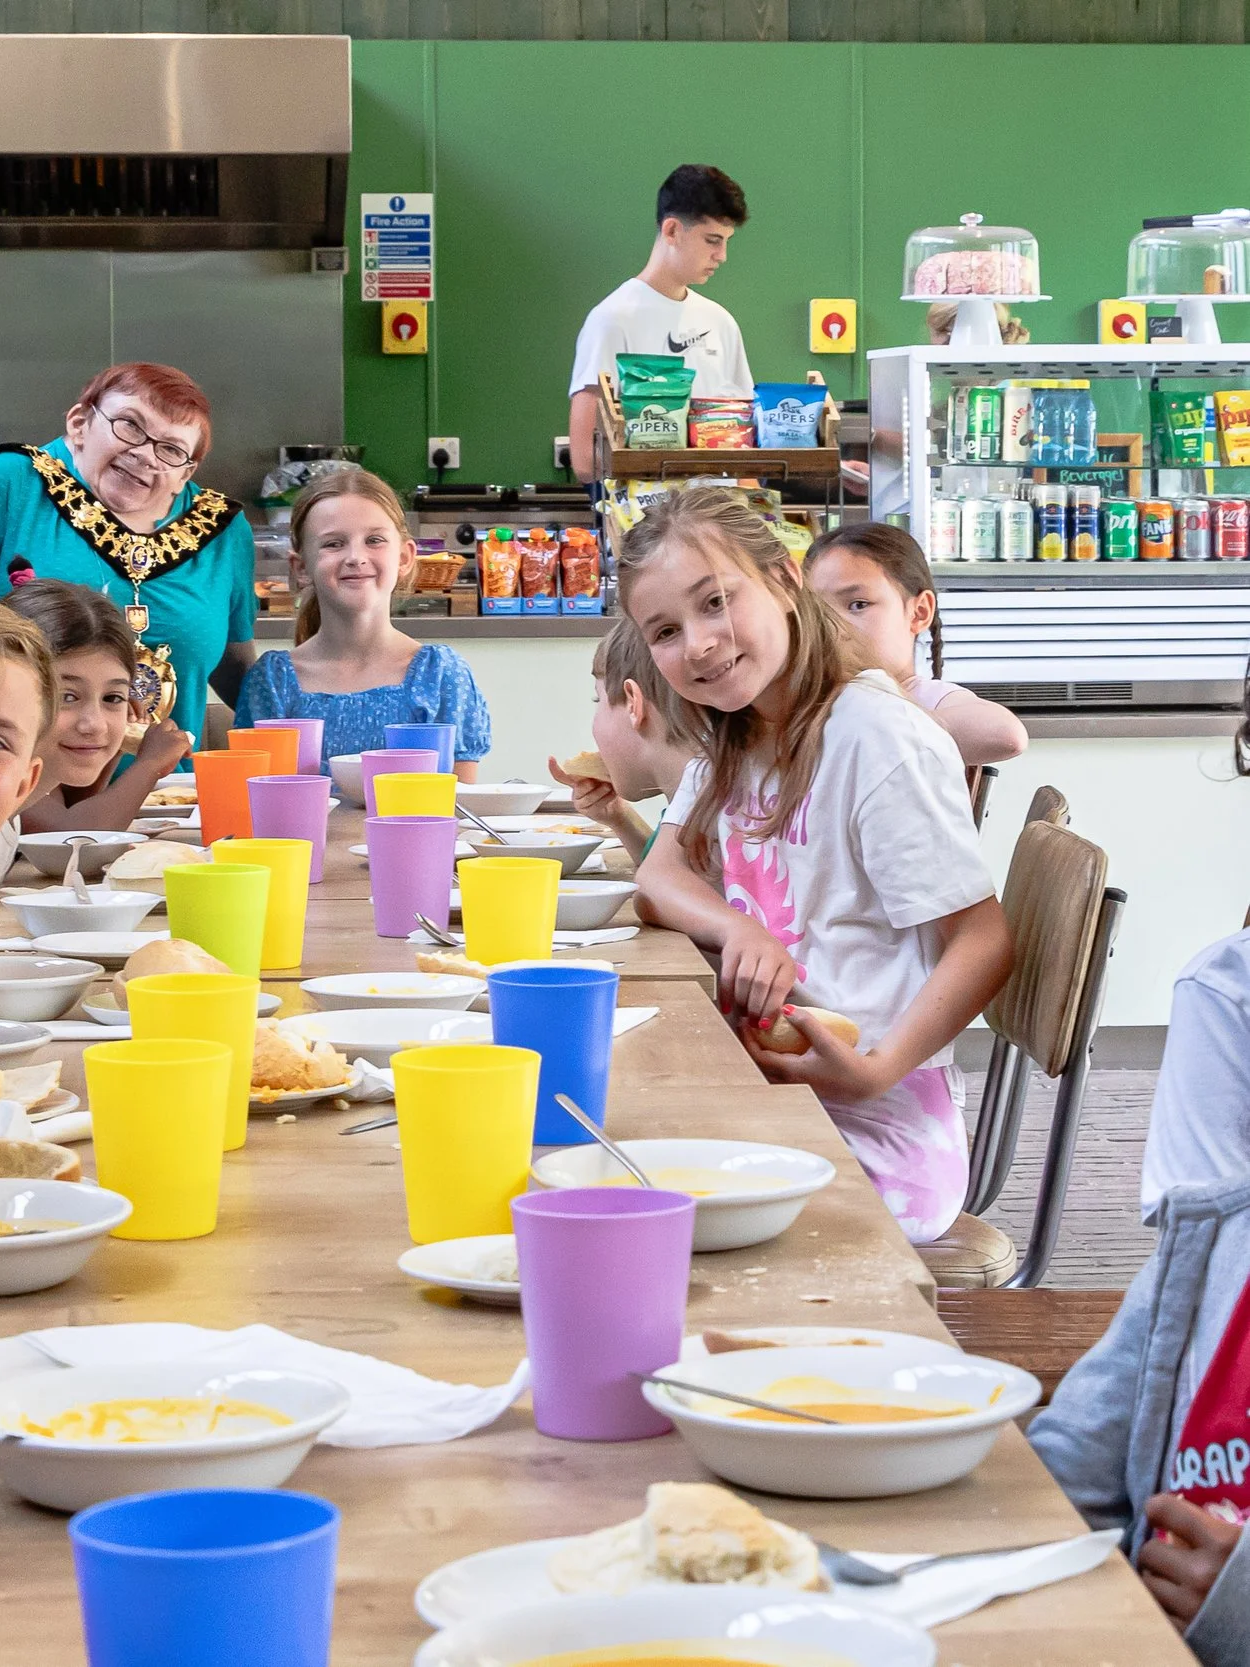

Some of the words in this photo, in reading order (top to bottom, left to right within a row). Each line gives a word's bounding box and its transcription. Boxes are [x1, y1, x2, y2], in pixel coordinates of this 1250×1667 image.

[370, 216, 391, 226] Fire
[392, 216, 425, 226] Action
[769, 413, 815, 424] PIPERS
[631, 422, 679, 433] PIPERS
[1059, 468, 1124, 487] Beverages
